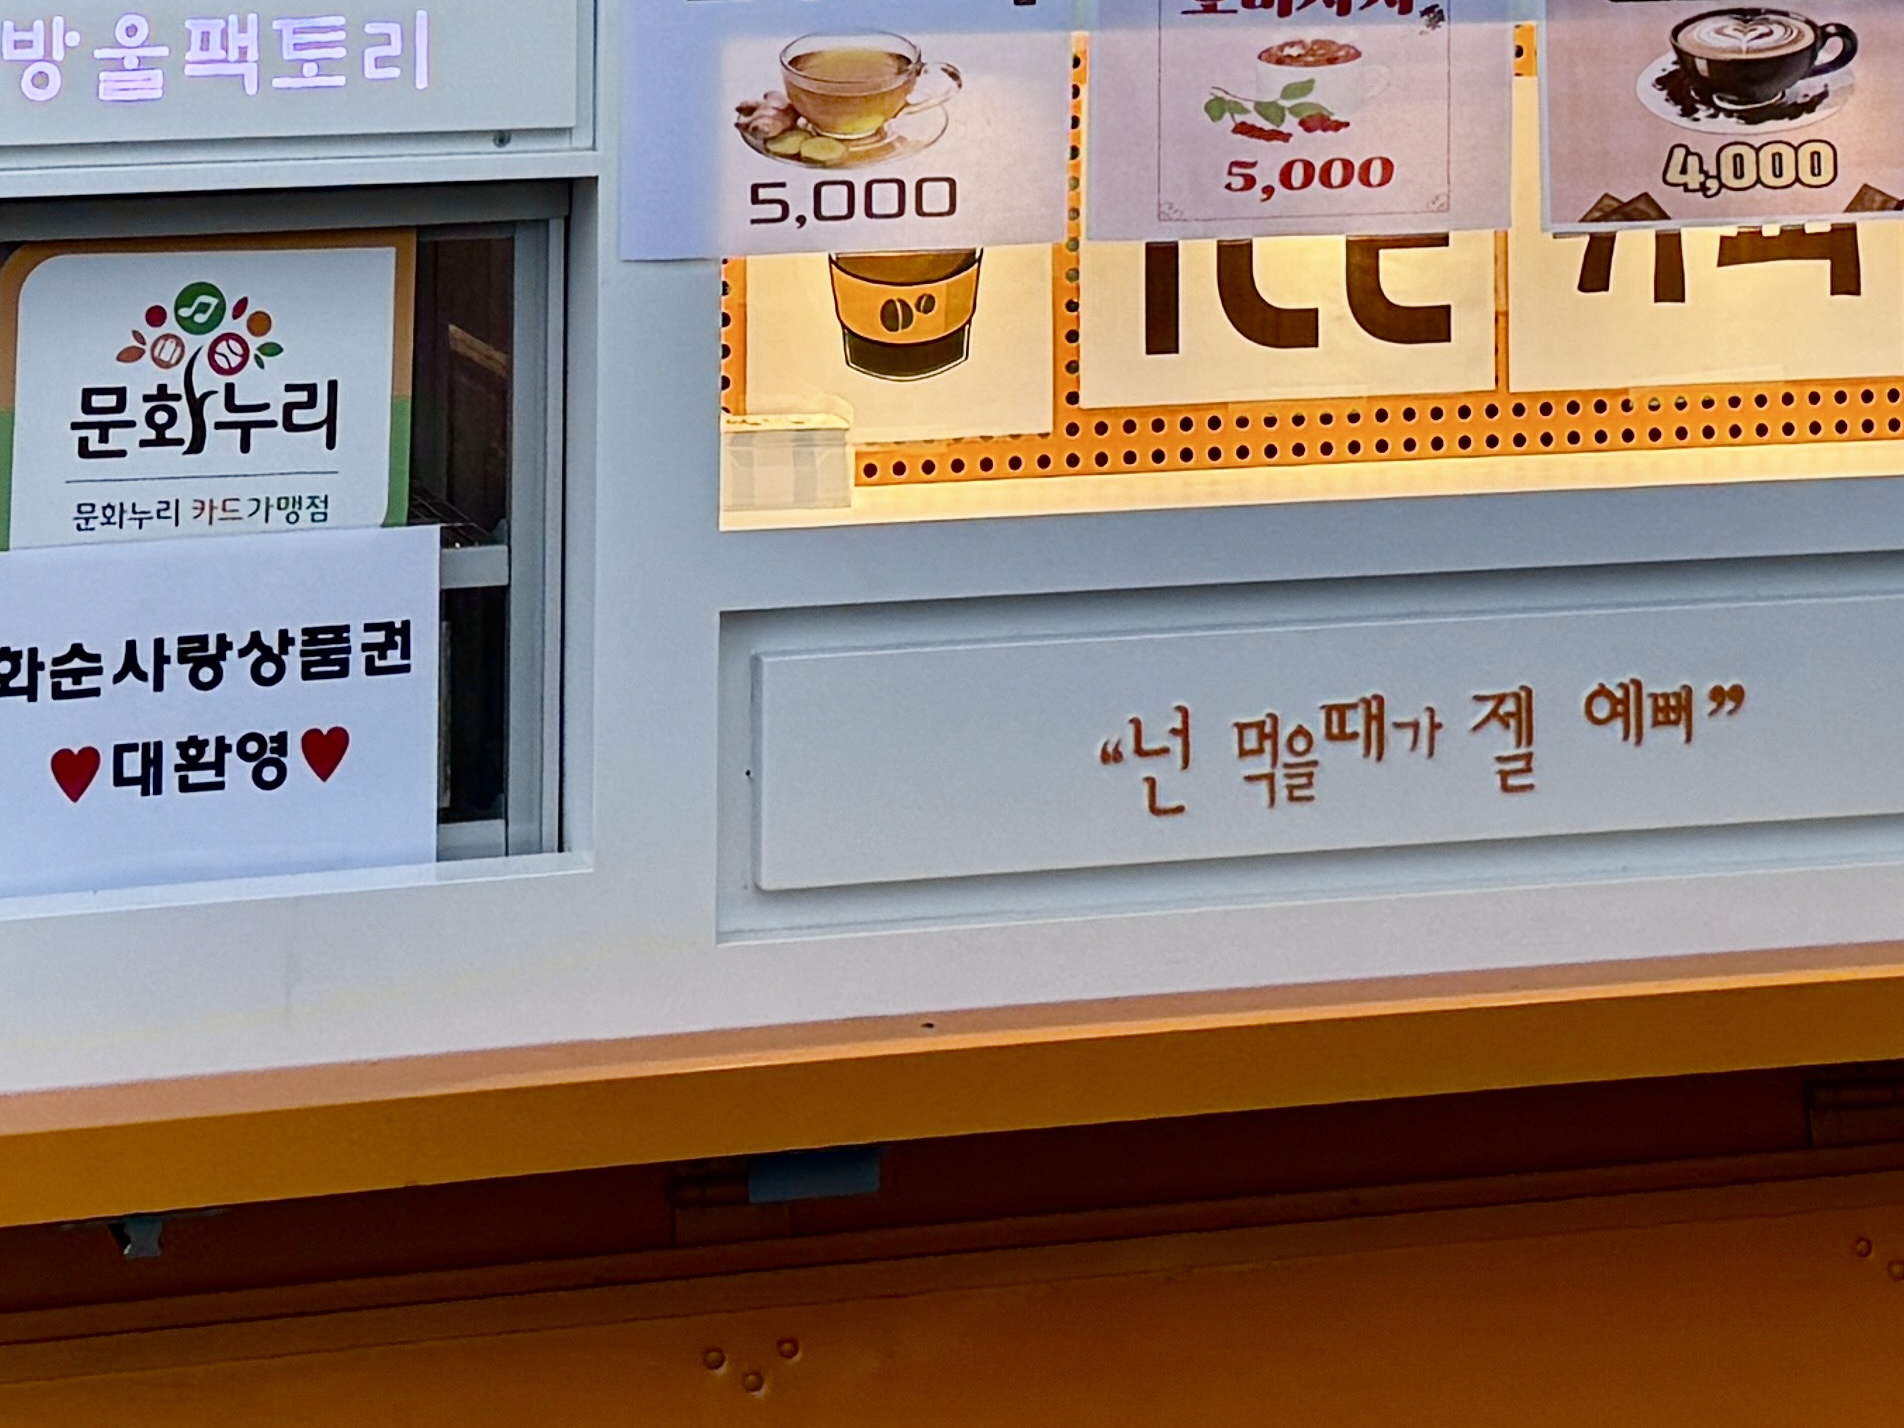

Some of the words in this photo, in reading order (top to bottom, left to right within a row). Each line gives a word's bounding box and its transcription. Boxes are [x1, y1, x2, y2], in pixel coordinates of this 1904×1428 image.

[0, 10, 430, 103] 방울팩토리
[1223, 155, 1396, 205] 5,000
[1661, 140, 1837, 195] 4,000
[748, 175, 959, 230] 5,000
[69, 376, 340, 461] 문화누리
[72, 497, 180, 532] 문화누리
[110, 730, 290, 799] 대환영
[1231, 693, 1443, 809] 먹을때가
[1470, 684, 1536, 794] 젤
